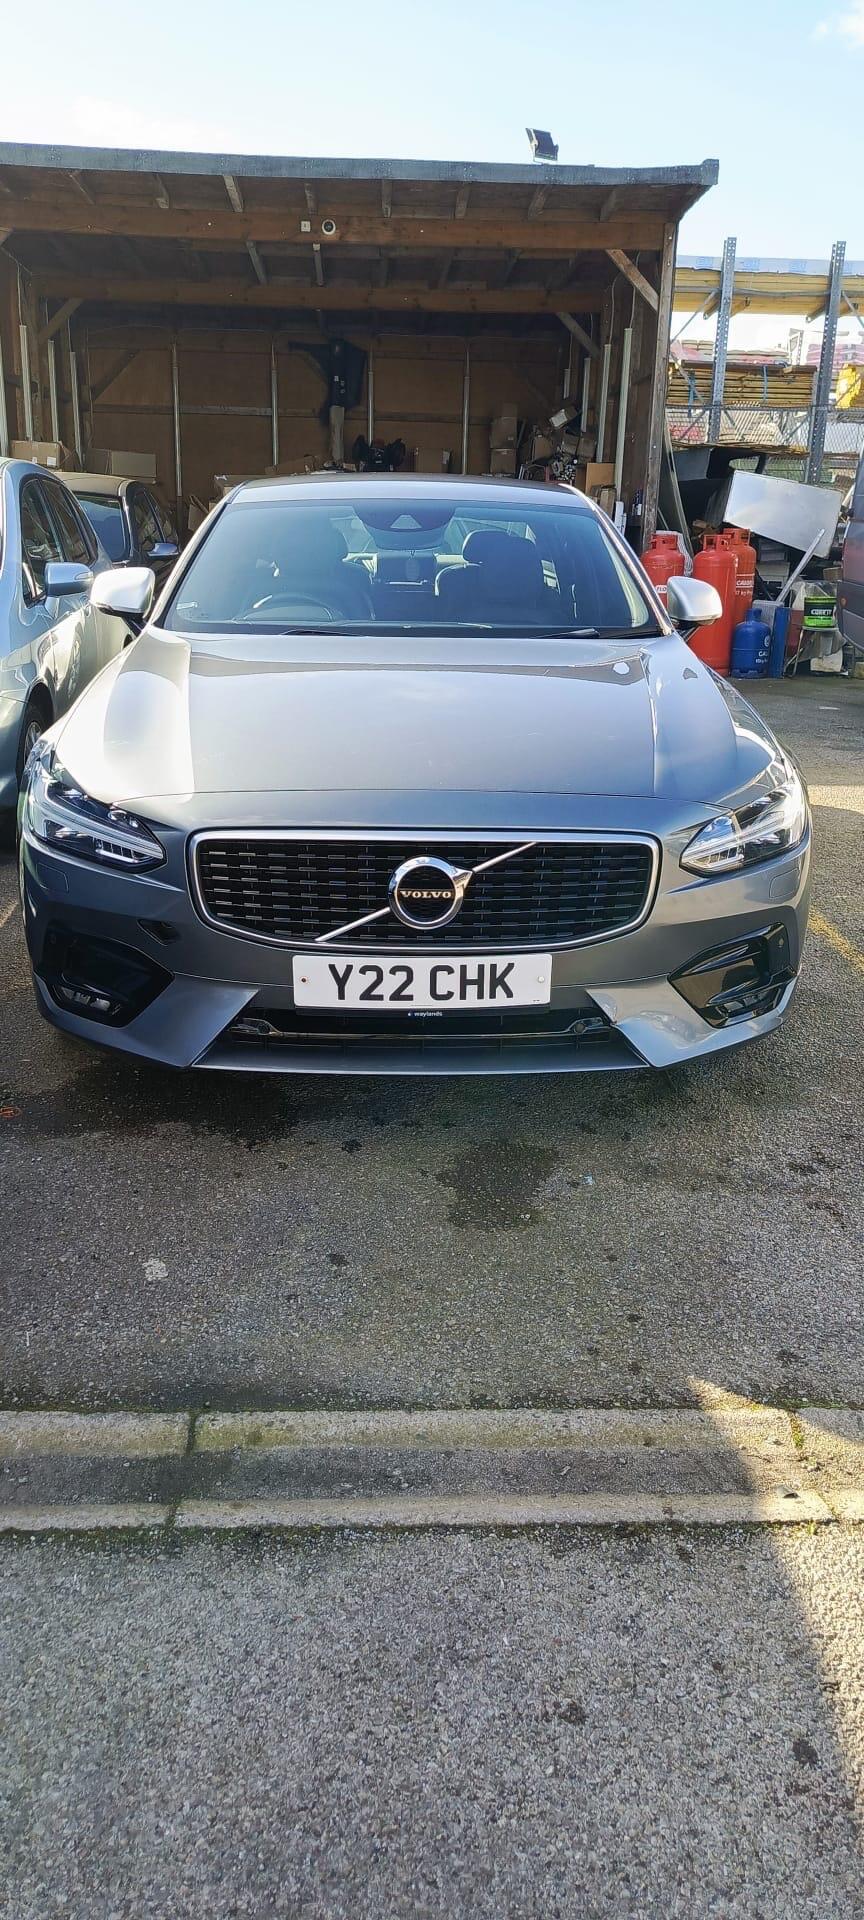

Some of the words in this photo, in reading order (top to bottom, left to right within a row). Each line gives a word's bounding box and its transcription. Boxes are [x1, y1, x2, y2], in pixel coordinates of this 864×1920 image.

[399, 890, 452, 899] VOLVO
[328, 963, 414, 1002] Y22
[429, 962, 515, 1001] CHK
[413, 1010, 443, 1018] waylands
